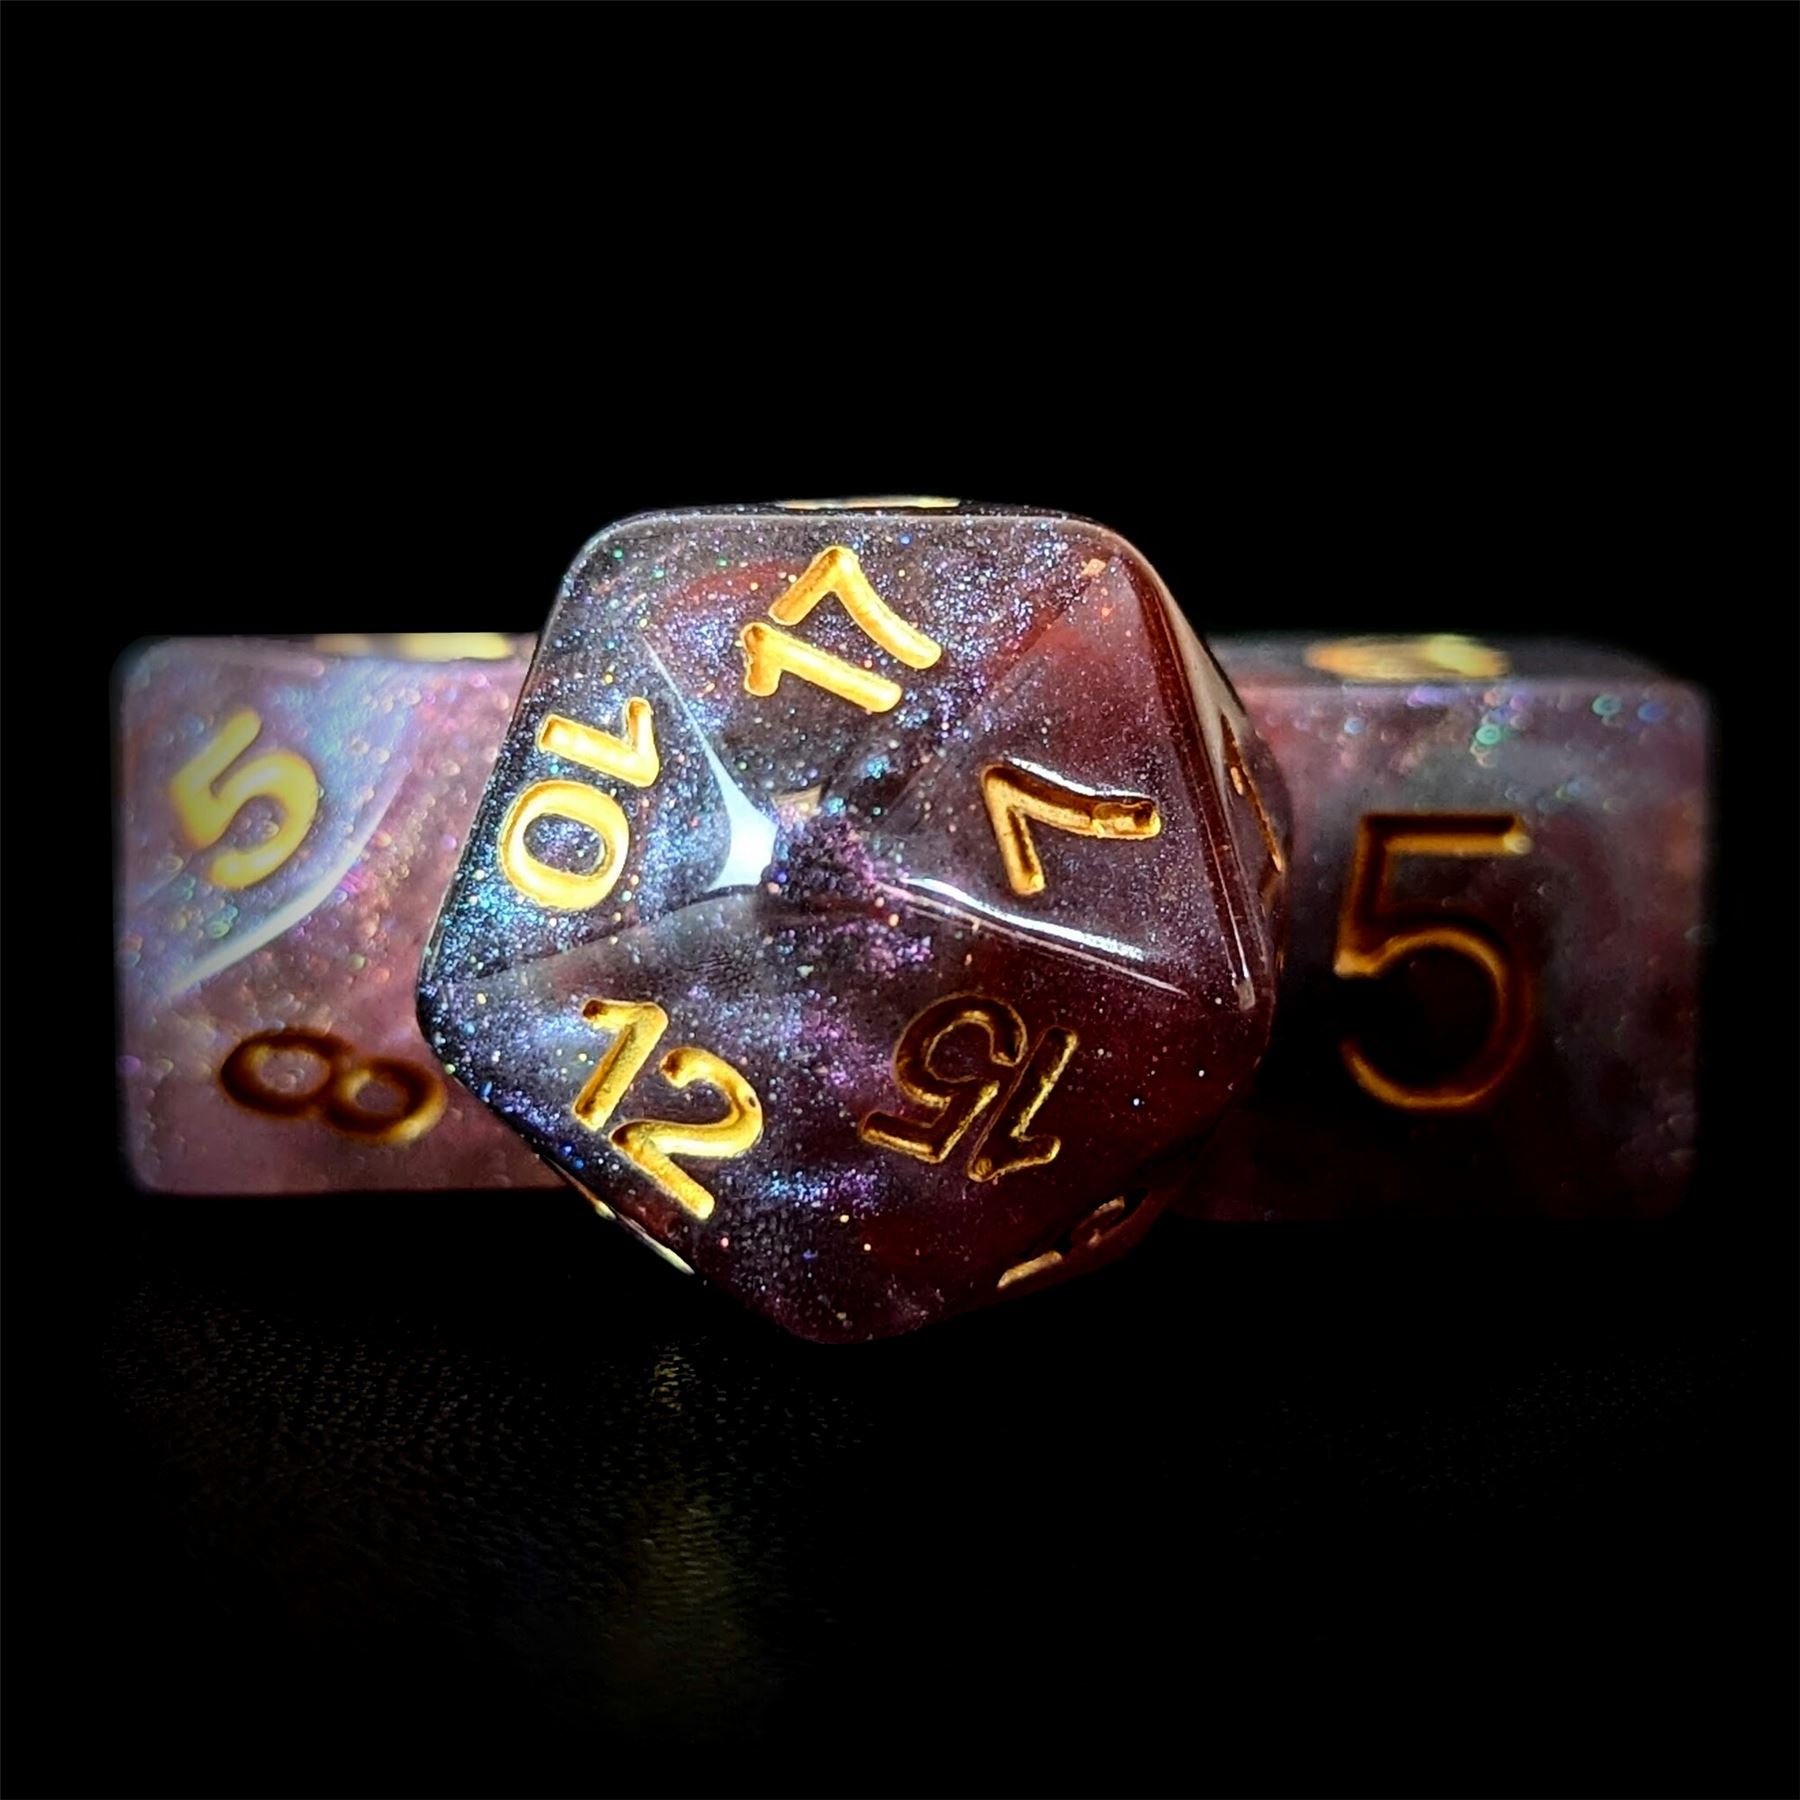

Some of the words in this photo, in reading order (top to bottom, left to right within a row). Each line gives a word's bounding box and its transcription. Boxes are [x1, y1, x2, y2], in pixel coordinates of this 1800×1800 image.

[740, 546, 942, 712] 17
[169, 708, 318, 889] 5
[498, 697, 661, 910] 10
[981, 760, 1161, 896] 7
[1334, 813, 1533, 1114] 5
[219, 1027, 446, 1144] 8
[572, 998, 764, 1219] 12
[860, 994, 1079, 1182] 15
